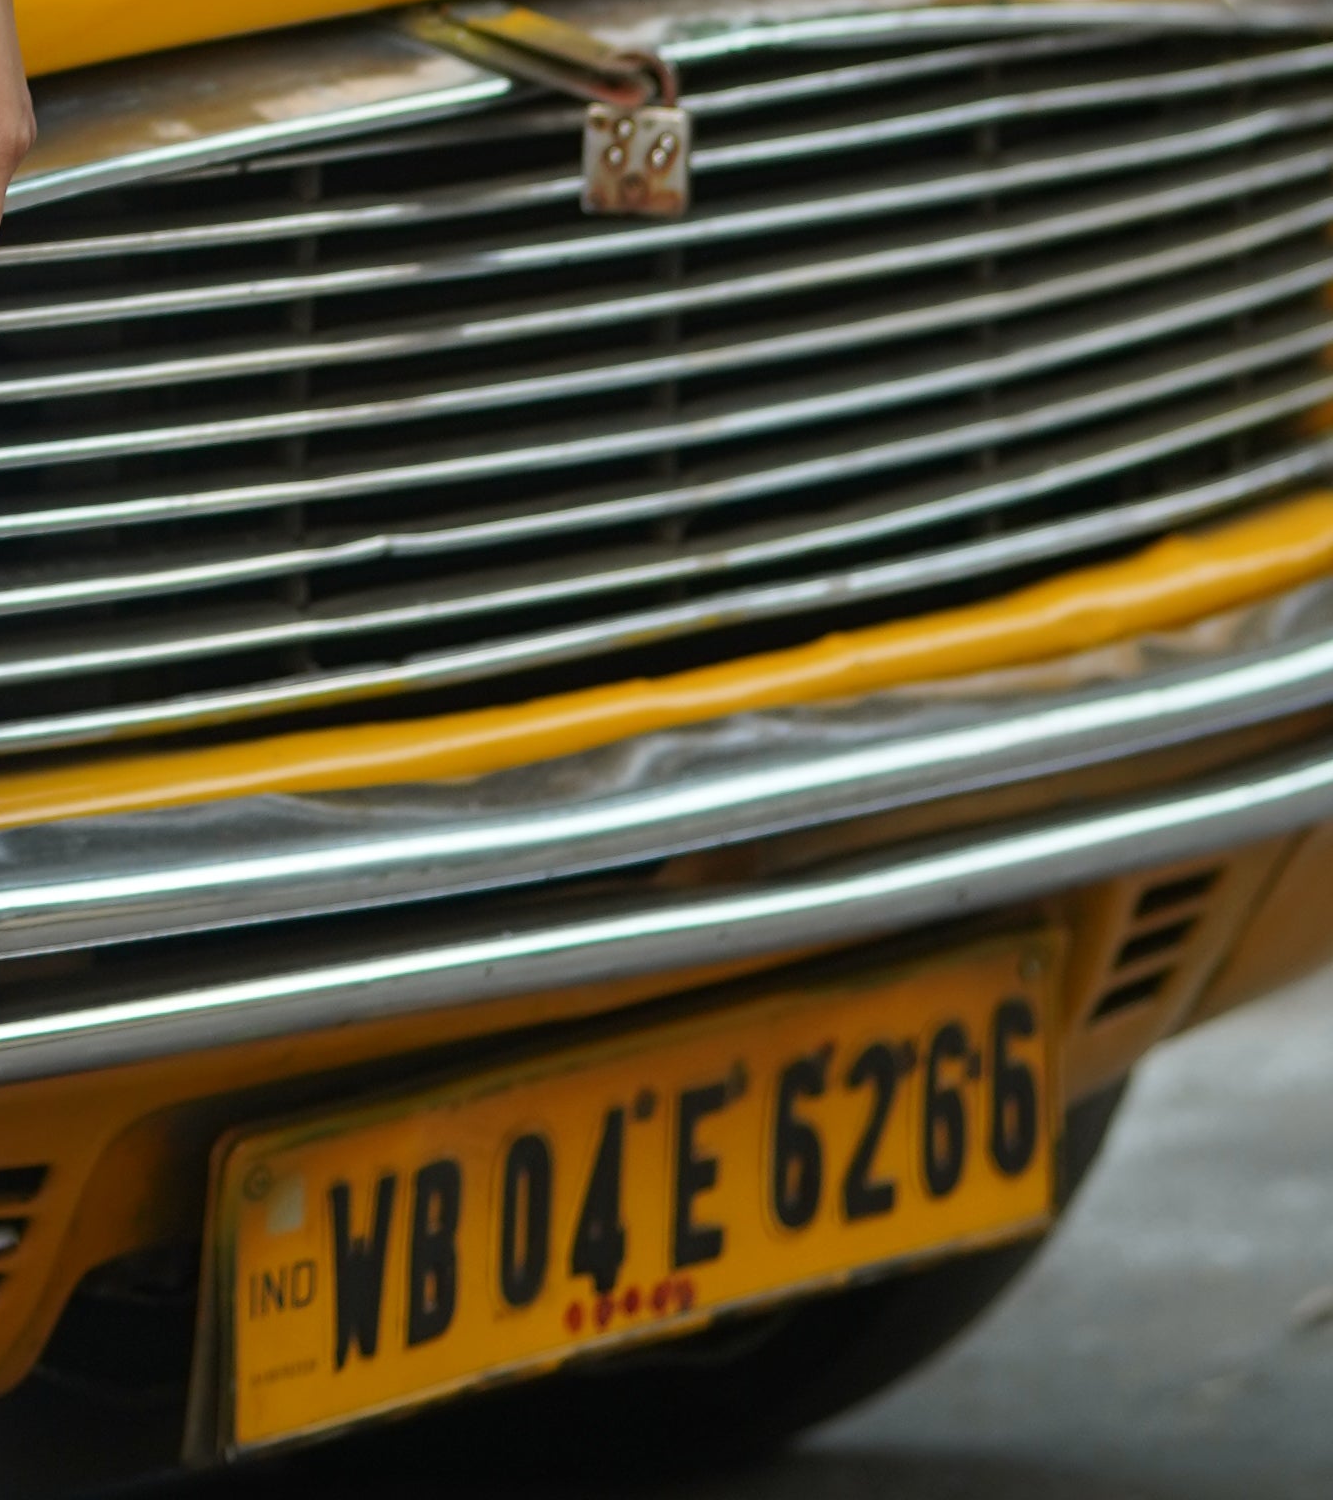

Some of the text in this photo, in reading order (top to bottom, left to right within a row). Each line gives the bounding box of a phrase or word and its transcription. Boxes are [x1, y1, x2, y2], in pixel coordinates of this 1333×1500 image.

[248, 1257, 319, 1321] IND
[329, 1157, 462, 1373] WB
[498, 1110, 627, 1307] 04
[773, 999, 1035, 1230] 6266
